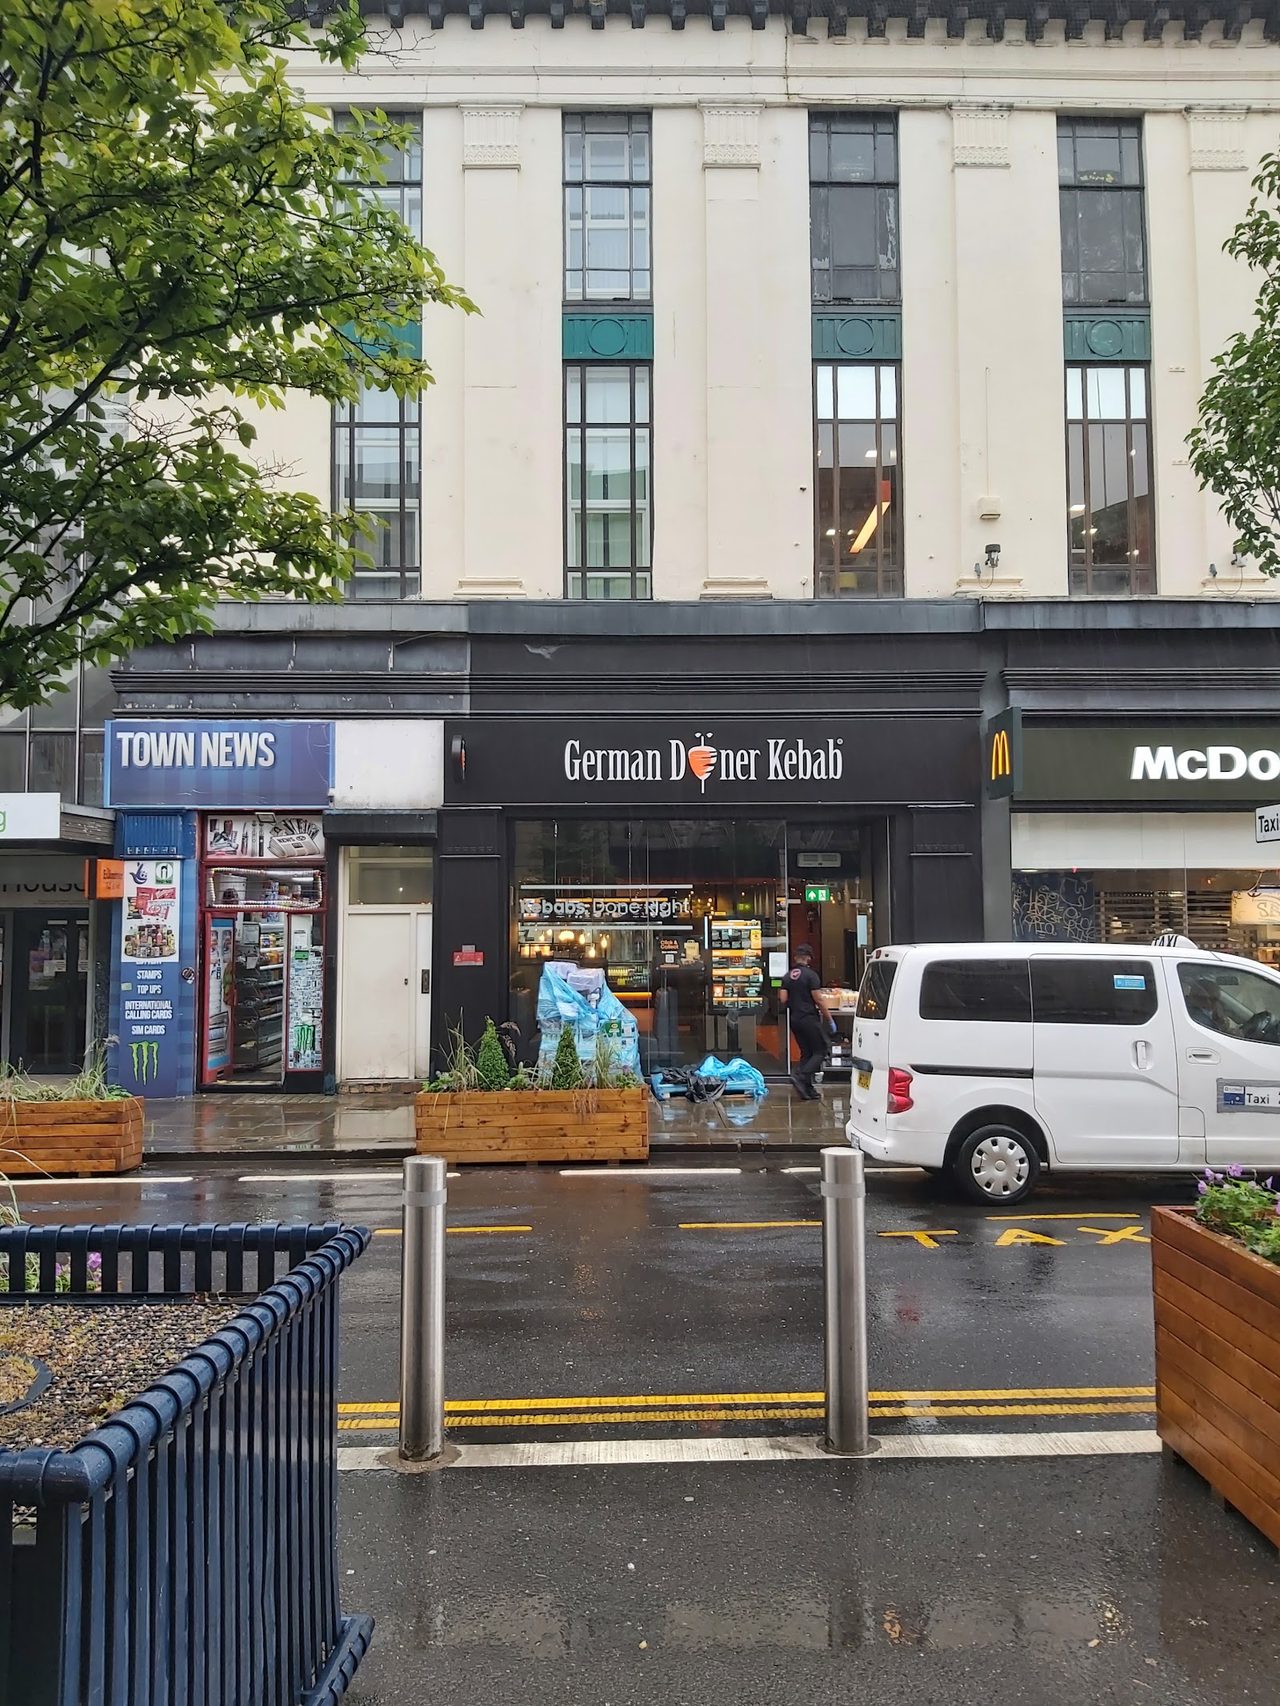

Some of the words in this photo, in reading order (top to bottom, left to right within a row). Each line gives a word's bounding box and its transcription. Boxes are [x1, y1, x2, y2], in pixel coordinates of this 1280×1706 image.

[116, 732, 195, 767] TOWN
[201, 732, 275, 767] NEWS
[564, 739, 662, 781] German
[1258, 813, 1280, 834] Taxi
[1153, 934, 1179, 948] TAXI
[136, 970, 162, 980] STAMPS
[137, 985, 149, 994] TOP
[150, 985, 162, 994] UPS
[125, 1001, 172, 1009] INTERNATIONAL
[125, 1009, 150, 1019] CALLING
[151, 1009, 172, 1019] CARDS
[131, 1025, 144, 1035] SIM
[145, 1025, 166, 1034] CARDS
[1246, 1092, 1270, 1105] Taxi
